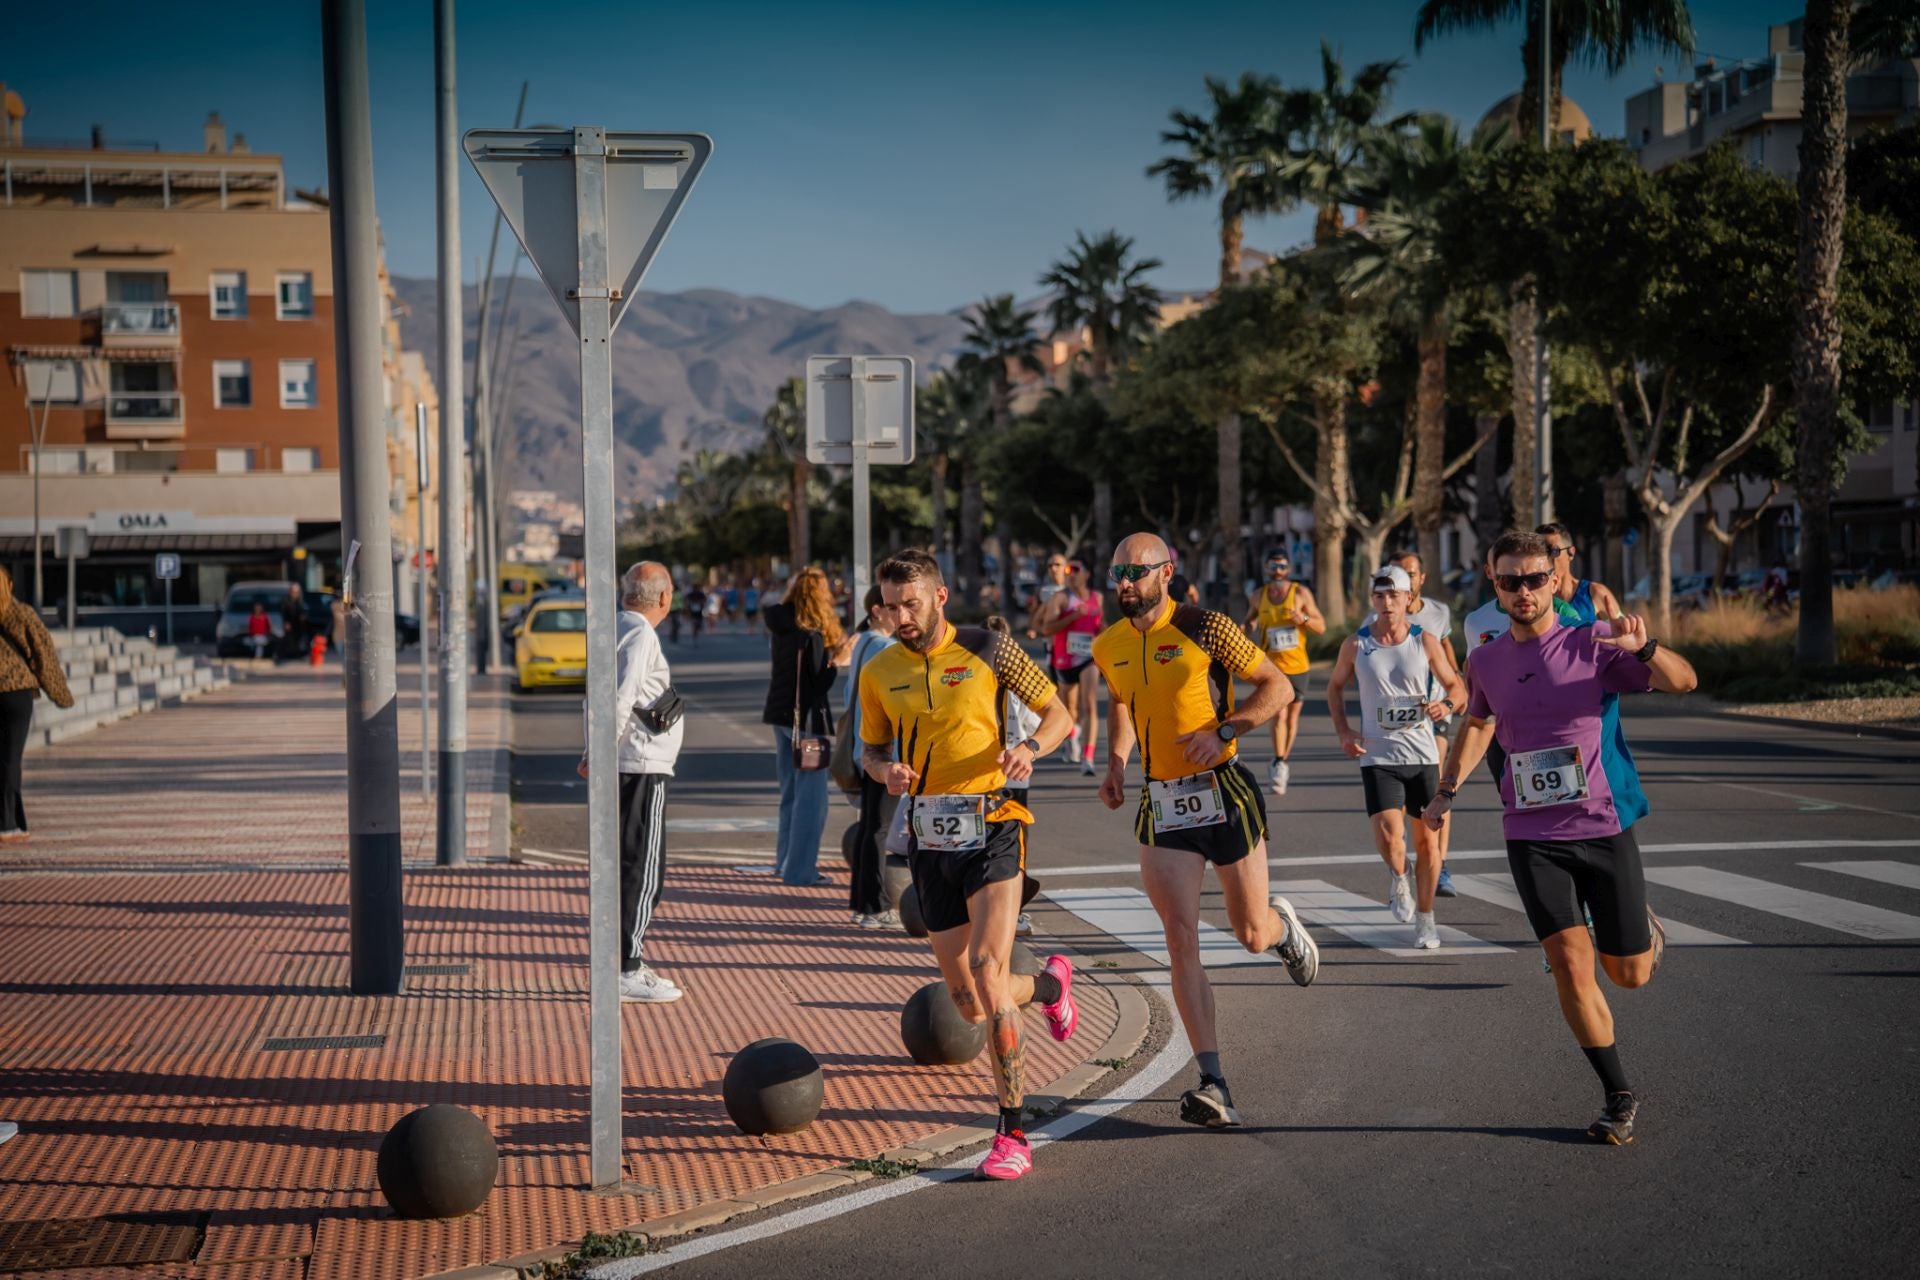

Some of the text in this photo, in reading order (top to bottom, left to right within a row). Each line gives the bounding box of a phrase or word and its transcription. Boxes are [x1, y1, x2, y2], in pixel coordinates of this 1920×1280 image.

[160, 556, 175, 577] P
[1385, 708, 1418, 721] 122
[1531, 770, 1562, 792] 69
[1173, 795, 1202, 816] 50
[932, 816, 961, 836] 52
